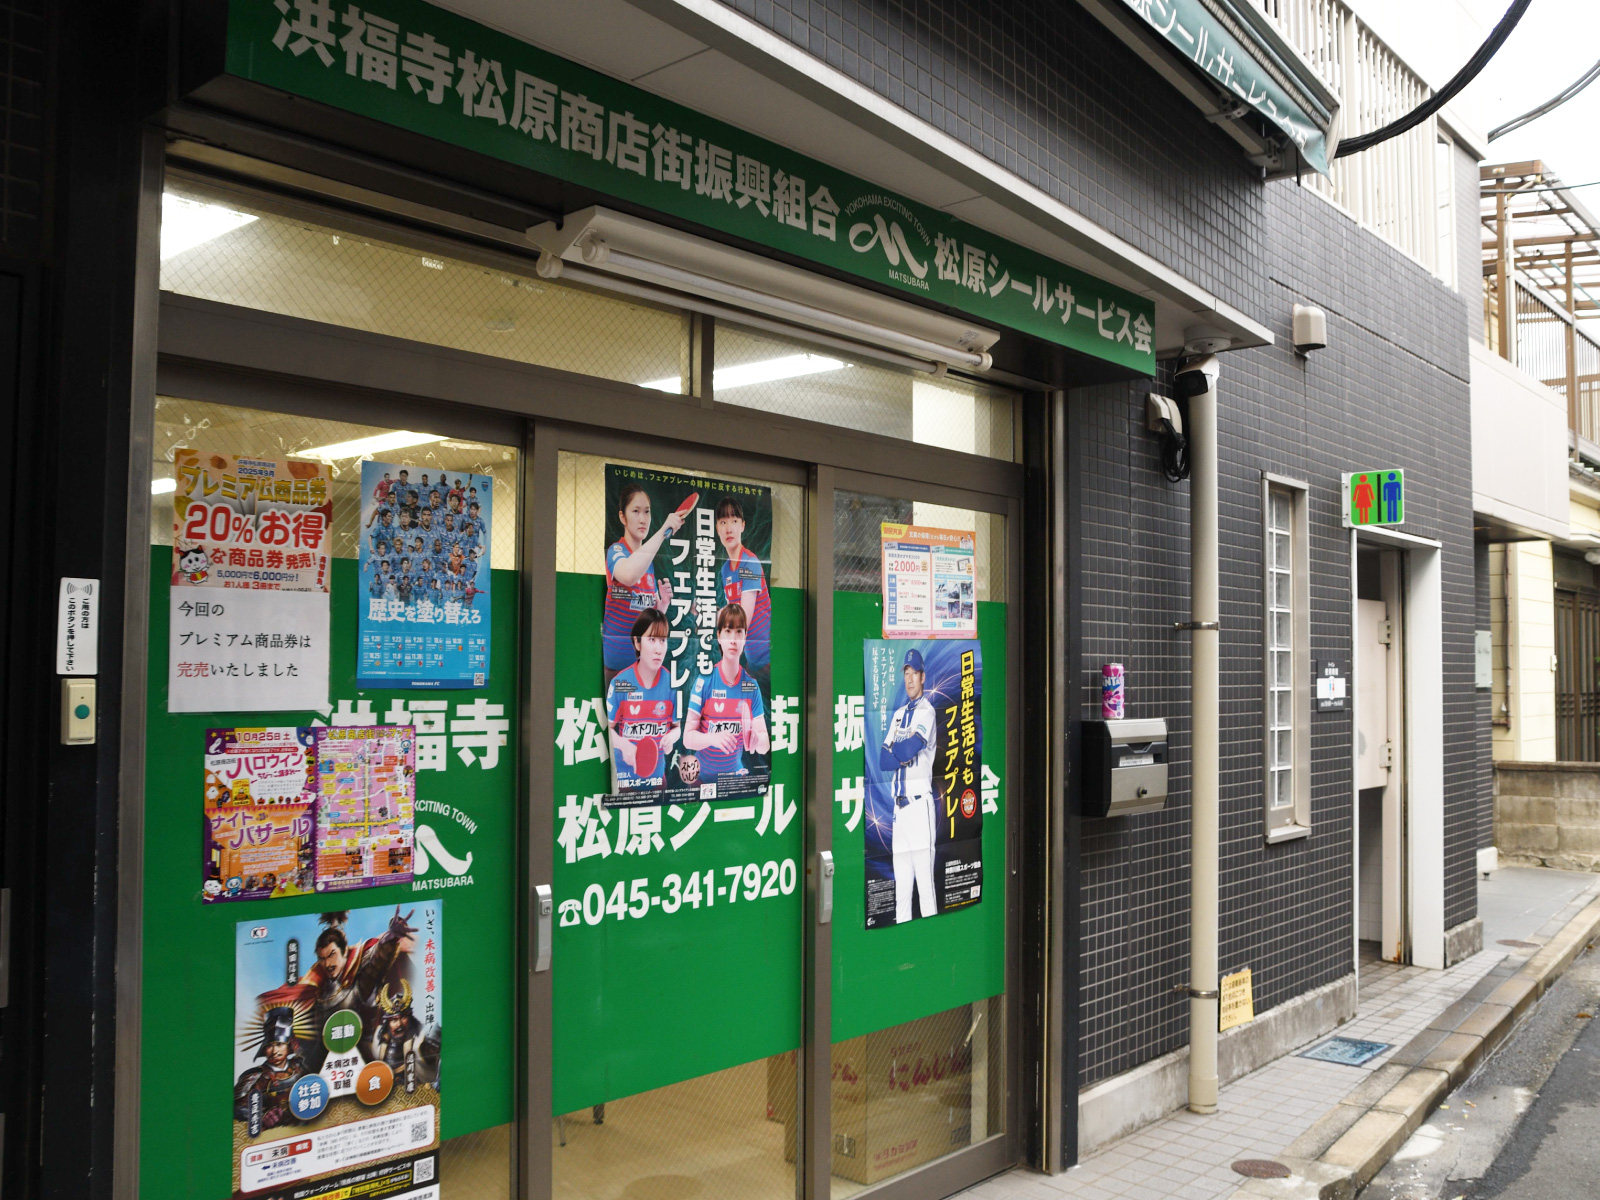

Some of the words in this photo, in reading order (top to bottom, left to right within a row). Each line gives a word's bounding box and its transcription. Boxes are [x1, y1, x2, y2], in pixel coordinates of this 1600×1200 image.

[845, 194, 881, 217] YOKOHAMA
[883, 196, 913, 223] EXCITING
[913, 217, 931, 247] TOWN
[888, 269, 930, 291] MATSUBARA
[934, 232, 1153, 355] 松原シールサービス会
[180, 466, 327, 507] プレミアム商品券
[184, 504, 325, 550] 20%お得
[695, 508, 717, 675] 日常生活でも
[178, 600, 225, 617] 今回の
[367, 598, 482, 625] 歴史を塗り替えろ
[179, 631, 312, 649] プレミアム商品券は
[670, 538, 692, 719] フェアプレー
[176, 661, 299, 678] 完売いたしました
[888, 648, 896, 686] いじめは、
[960, 649, 976, 786] 日常生活でも
[226, 753, 303, 779] ハロウィン
[944, 705, 960, 839] フェアプレー
[212, 811, 254, 830] ナイト
[451, 807, 478, 835] TOWN
[229, 818, 310, 850] バザール
[412, 875, 474, 892] MATSUBARA
[582, 858, 798, 923] 045-341-7920
[330, 1022, 356, 1041] 運動
[325, 1056, 359, 1071] 未病改善
[330, 1070, 354, 1082] 3つの
[297, 1081, 322, 1099] 社会
[334, 1078, 351, 1090] 取組
[368, 1075, 382, 1092] 食
[298, 1096, 322, 1113] 参加
